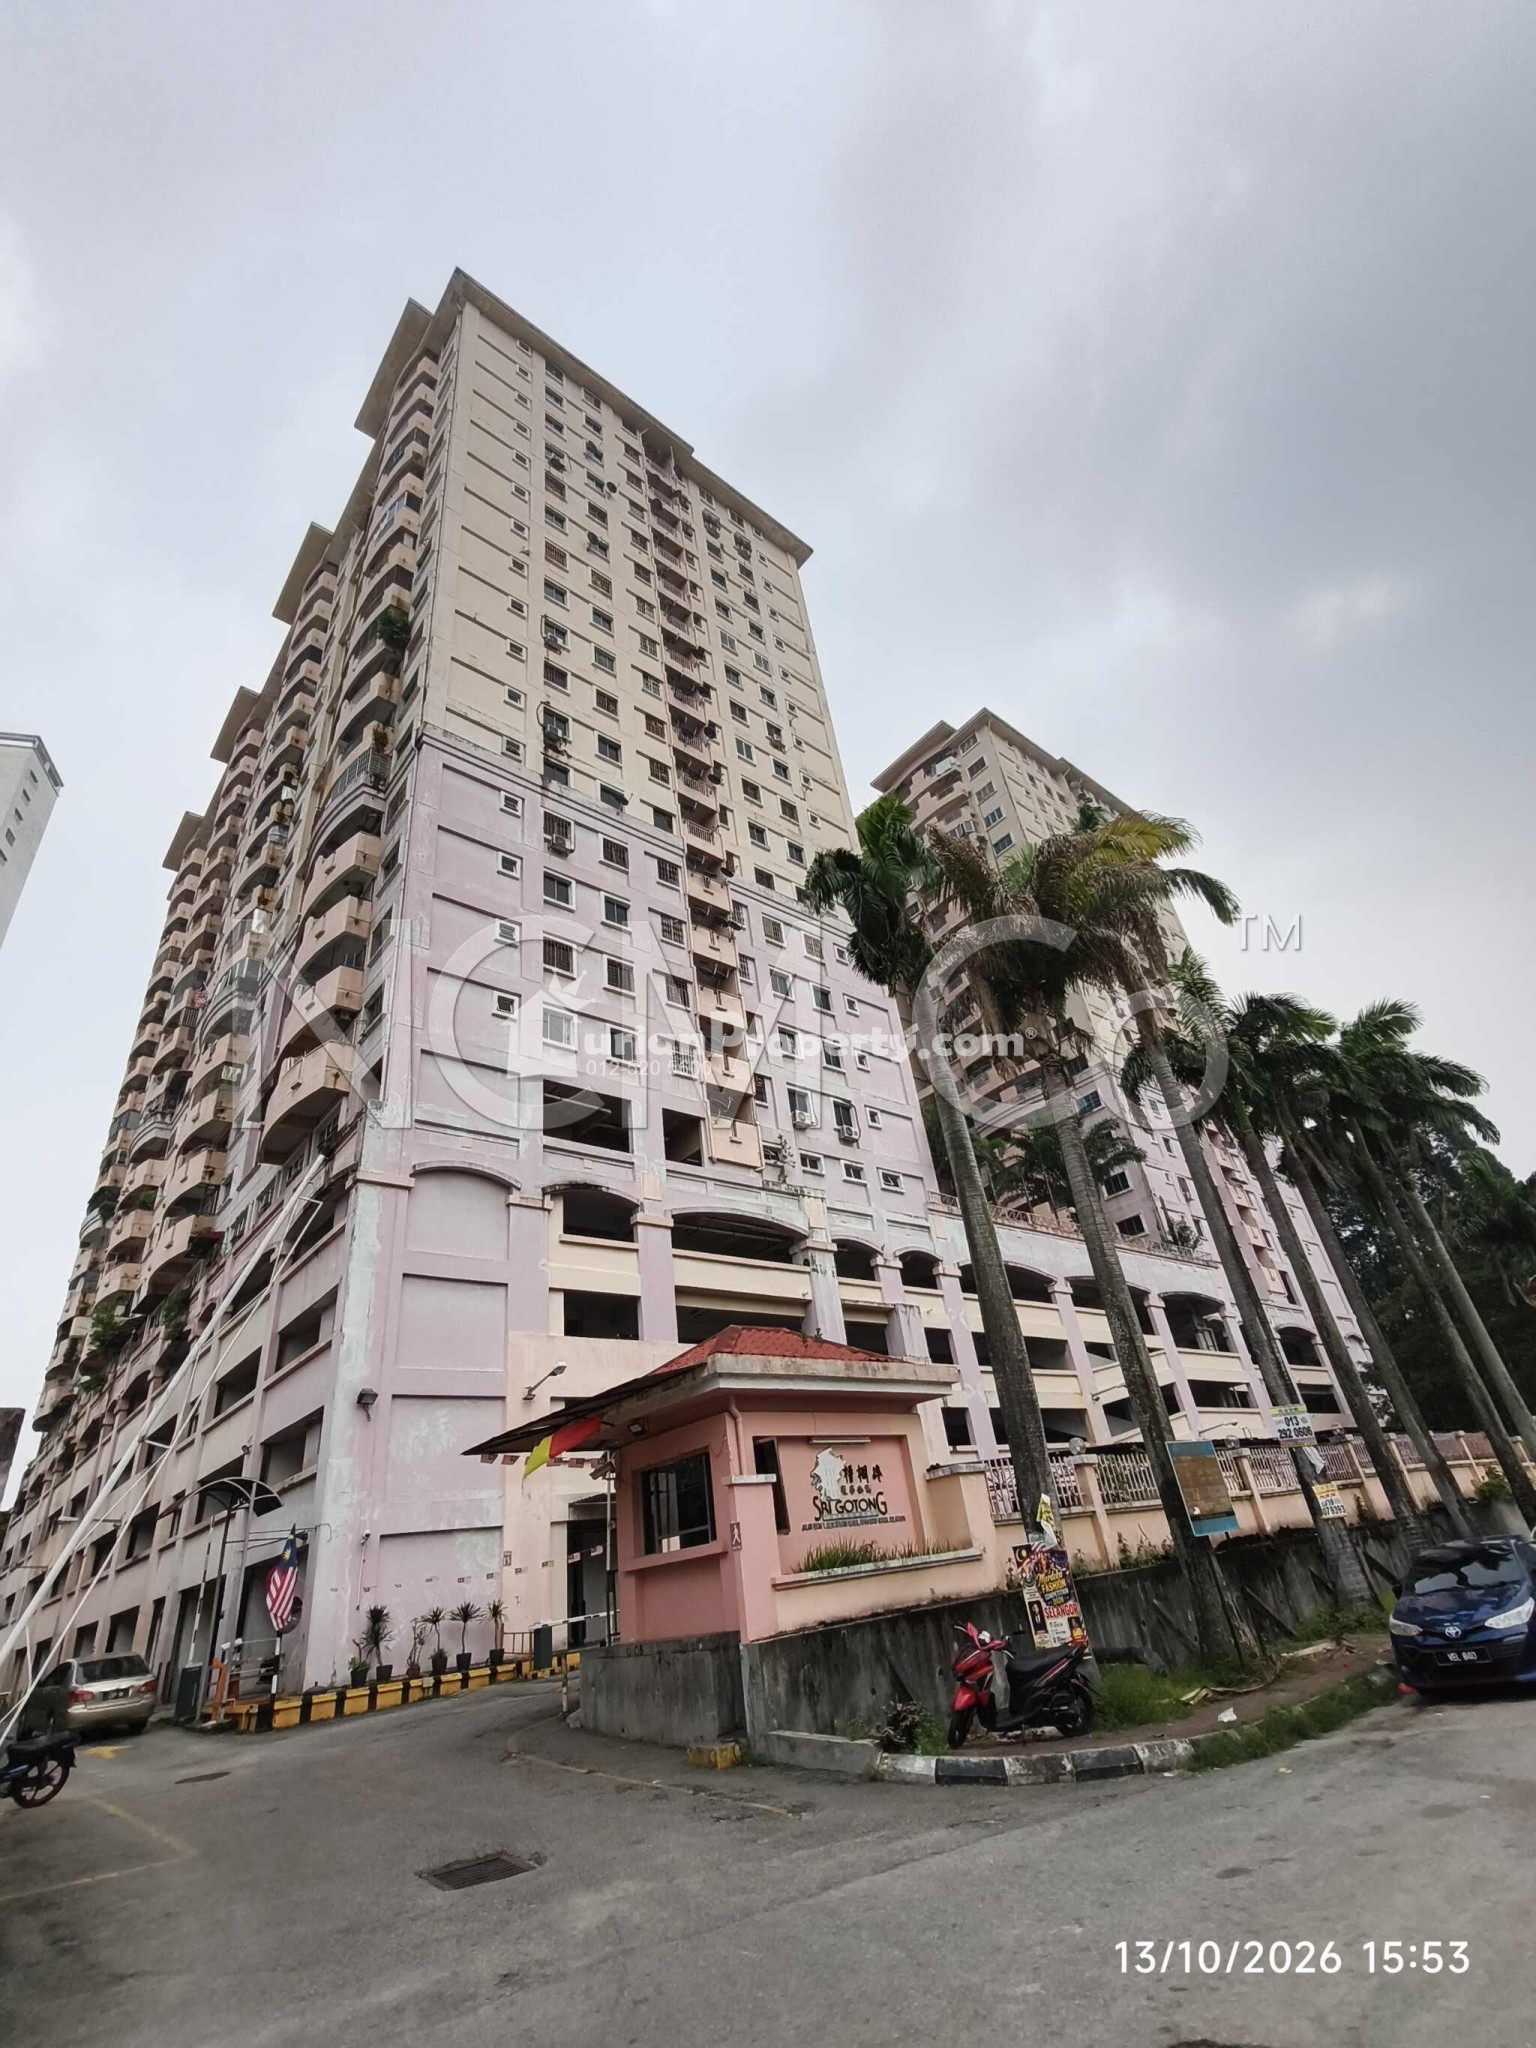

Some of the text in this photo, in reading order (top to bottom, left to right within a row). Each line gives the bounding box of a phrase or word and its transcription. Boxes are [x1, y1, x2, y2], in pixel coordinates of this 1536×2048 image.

[1284, 1416, 1300, 1427] 013
[1278, 1428, 1293, 1439] 292
[813, 1491, 888, 1522] SRI GOTONG
[1044, 1603, 1078, 1619] SELANGOR
